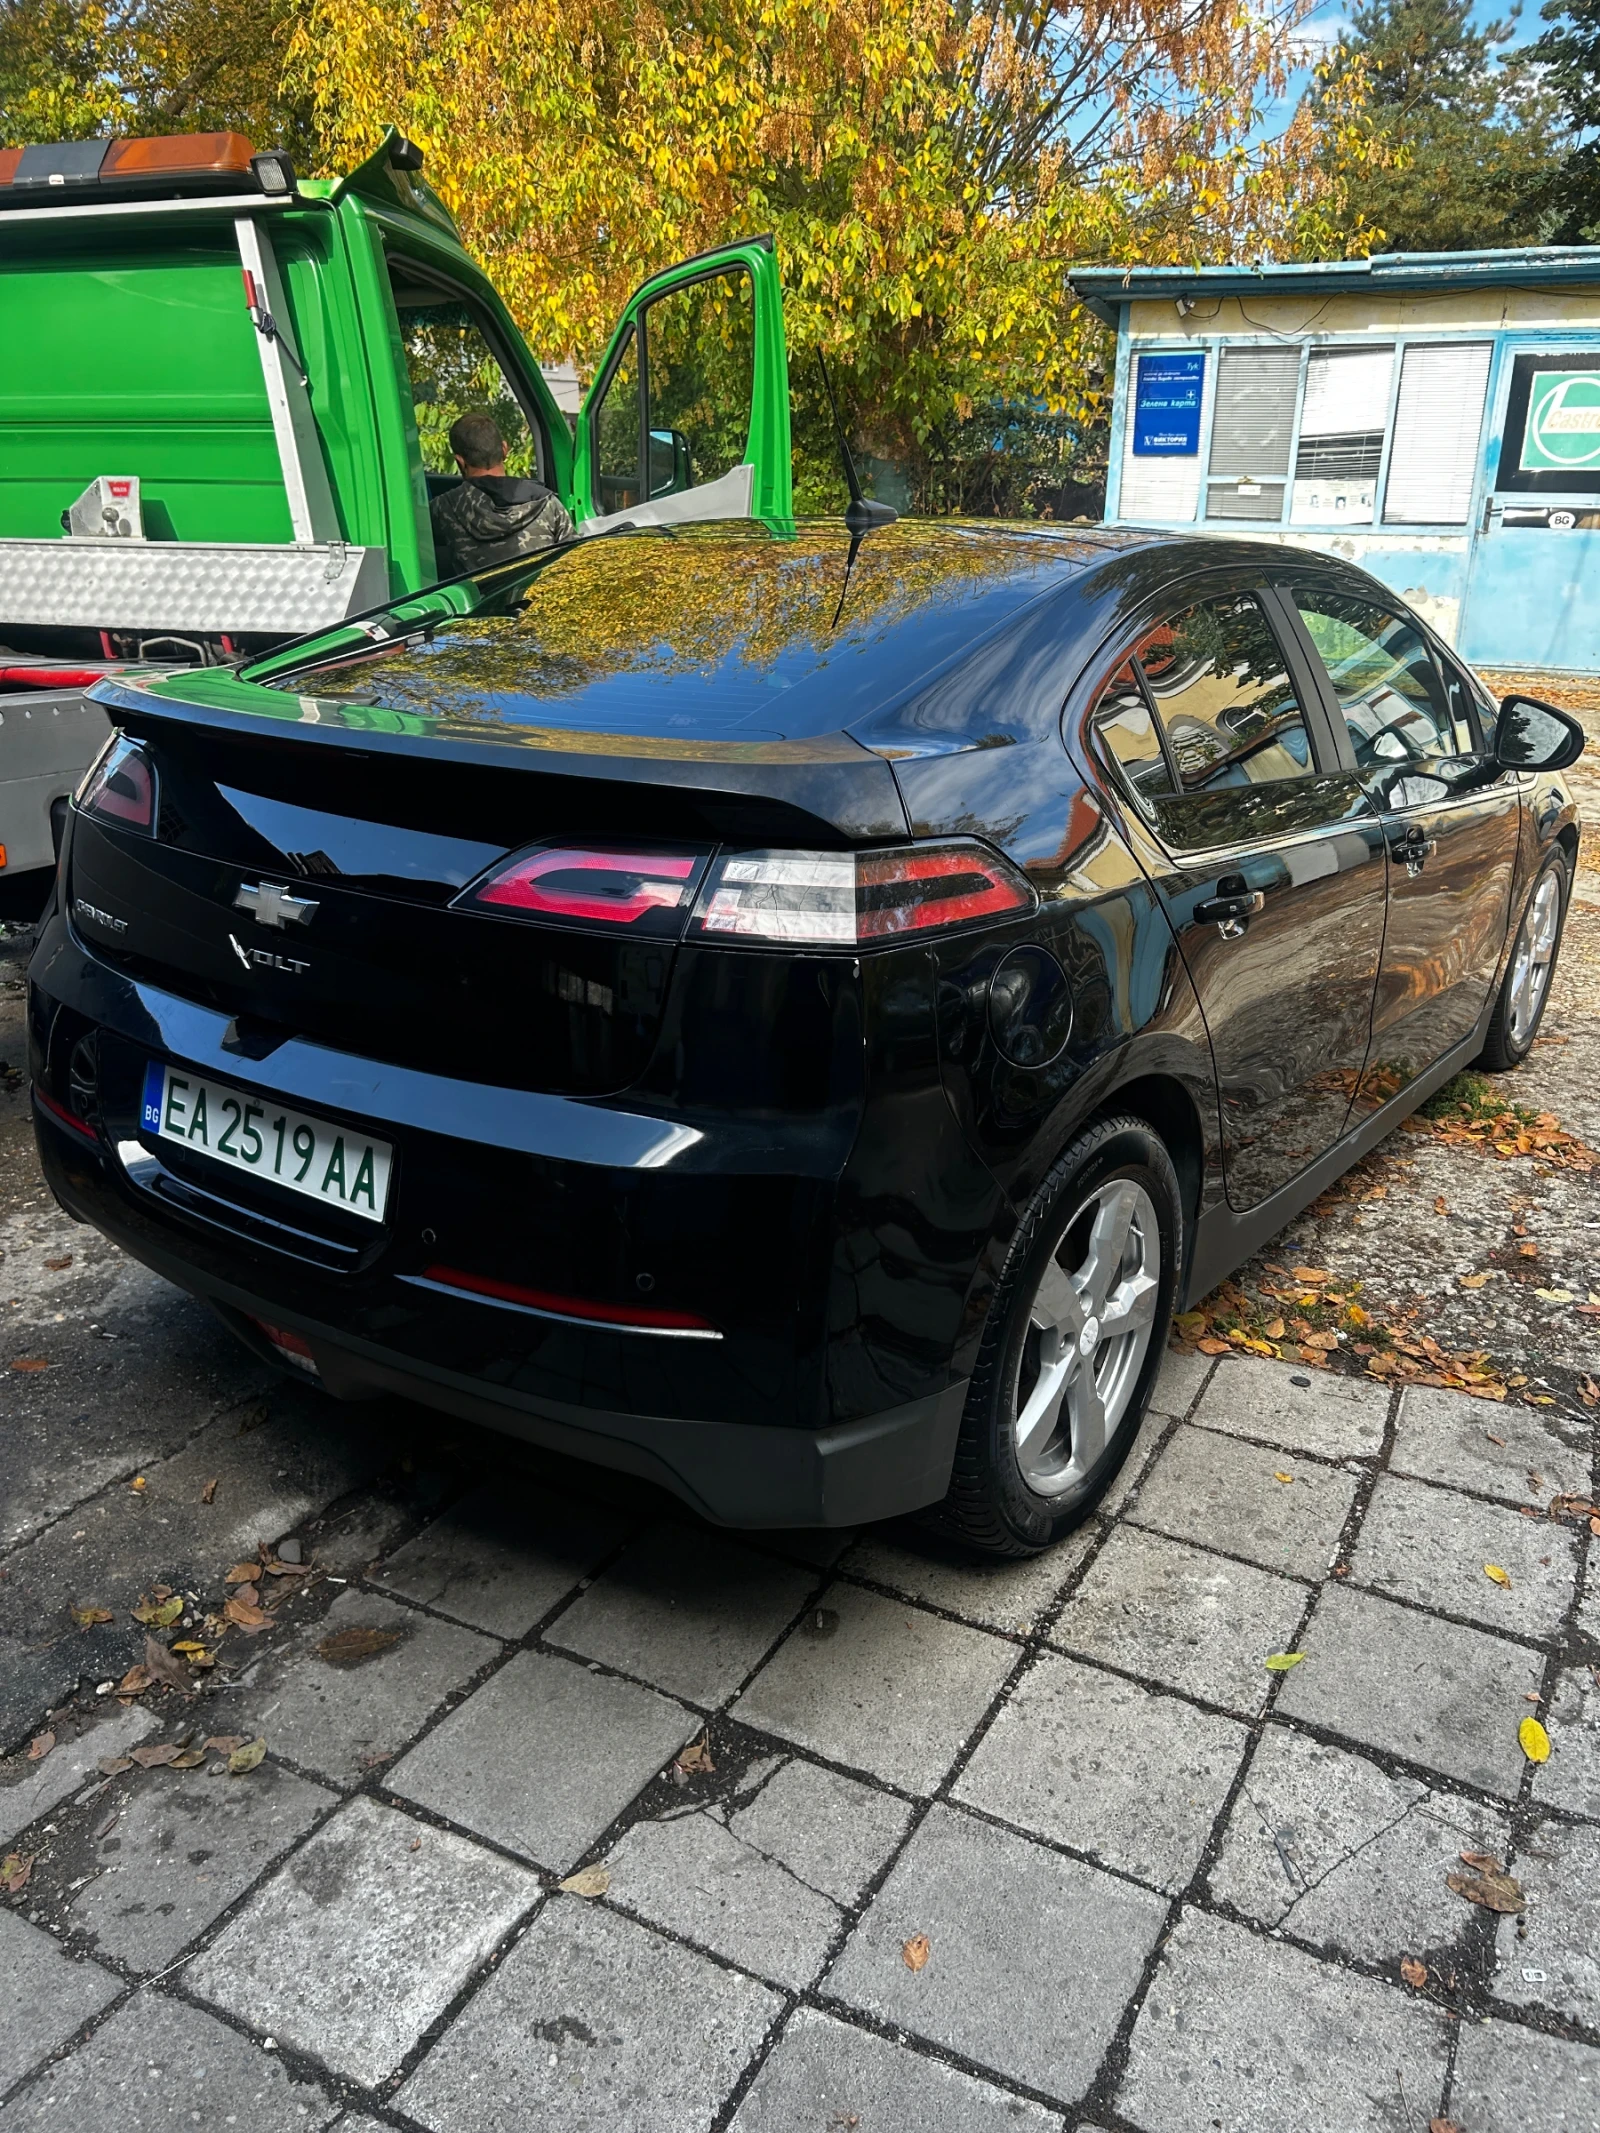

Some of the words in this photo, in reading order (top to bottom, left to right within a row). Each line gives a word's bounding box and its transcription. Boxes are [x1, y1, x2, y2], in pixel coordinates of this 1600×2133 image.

[1187, 362, 1199, 371] Тук
[1140, 400, 1168, 408] Зелена
[1171, 399, 1196, 408] карта
[1554, 515, 1570, 525] BG
[229, 933, 311, 974] VOLT
[145, 1104, 159, 1124] BG
